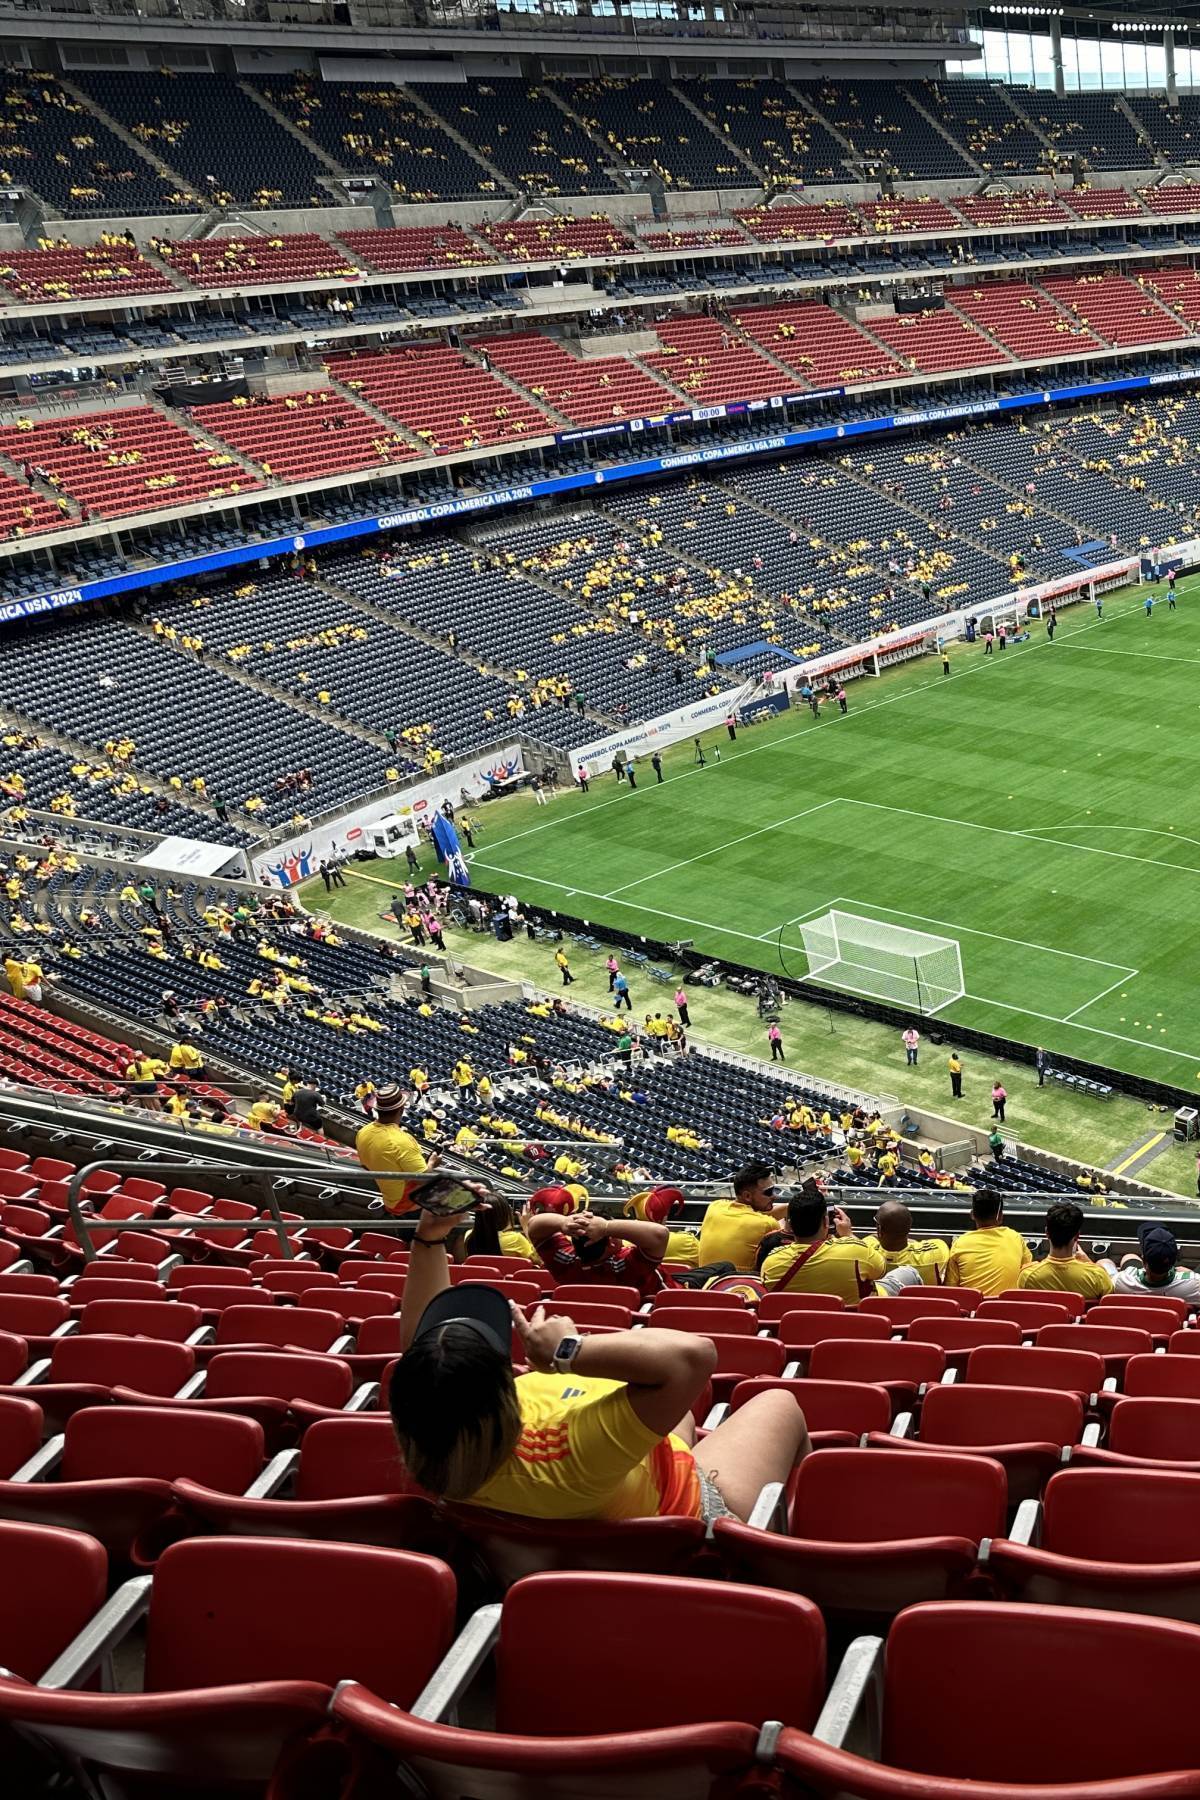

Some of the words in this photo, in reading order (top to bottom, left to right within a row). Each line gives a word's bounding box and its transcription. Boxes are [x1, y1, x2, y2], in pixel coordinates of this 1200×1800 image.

[893, 413, 929, 425] CONMEBOL
[928, 410, 946, 420] COPA
[945, 406, 973, 419] AMERICA
[973, 403, 985, 413] USA
[984, 401, 1000, 410] 2024
[660, 453, 703, 468] CONMEBOL
[703, 450, 723, 460] COPA
[723, 445, 755, 458] AMERICA
[755, 441, 769, 451] USA
[768, 437, 786, 448] 2024
[378, 509, 430, 529] CONMEBOL
[430, 505, 456, 518] COPA
[456, 497, 495, 513] AMERICA
[495, 493, 512, 504] USA
[512, 487, 533, 500] 2024
[24, 599, 52, 613] USA
[51, 590, 83, 607] 2024
[690, 704, 719, 719] CONMEBOL
[530, 1147, 539, 1157] 10
